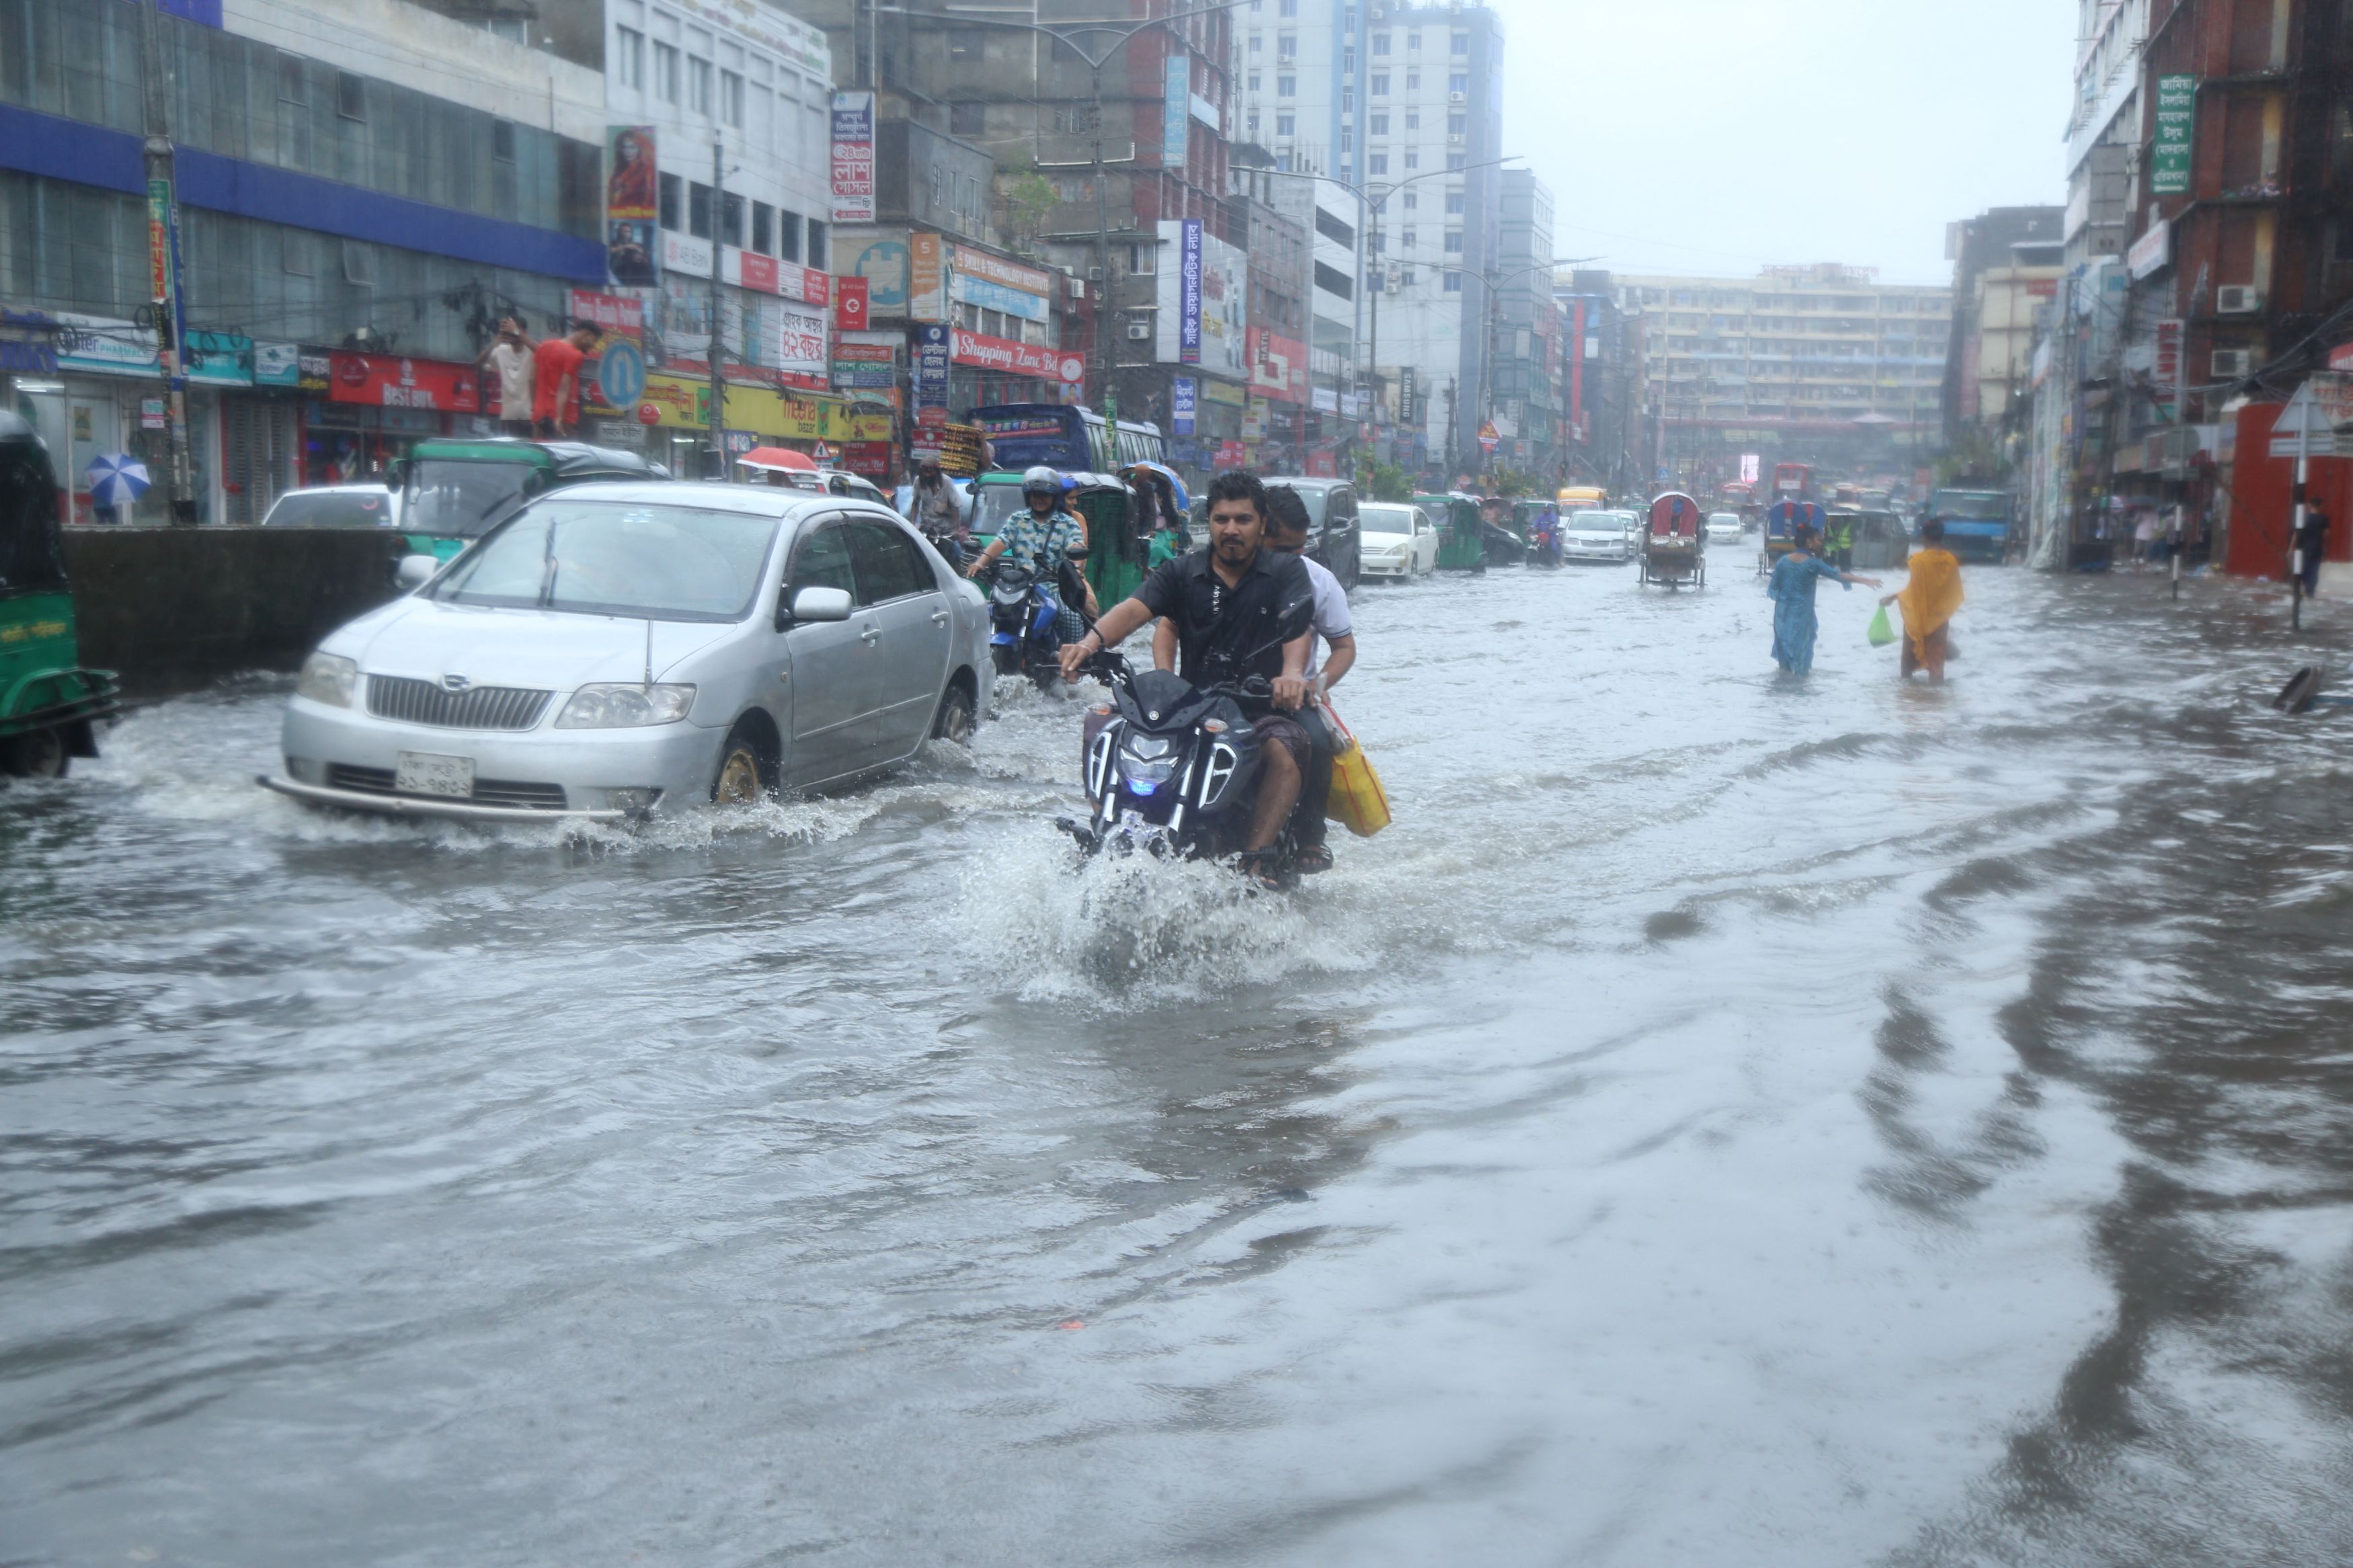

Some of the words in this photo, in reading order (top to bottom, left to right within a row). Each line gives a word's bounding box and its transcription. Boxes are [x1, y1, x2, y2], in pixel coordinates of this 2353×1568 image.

[834, 161, 872, 180] লাশ
[834, 180, 872, 194] গোসল
[1188, 224, 1199, 250] ল্যাব
[988, 259, 1023, 286] TECHNOLOGY
[1023, 268, 1049, 293] INSTITUTE
[1185, 318, 1197, 345] সাইক
[799, 334, 823, 362] বছর
[960, 335, 1013, 368] Shopping
[1016, 346, 1042, 368] Zone
[1261, 330, 1269, 362] HATIL
[1402, 373, 1412, 418] SAMSUNG
[784, 398, 816, 421] meena
[798, 419, 816, 434] bazar
